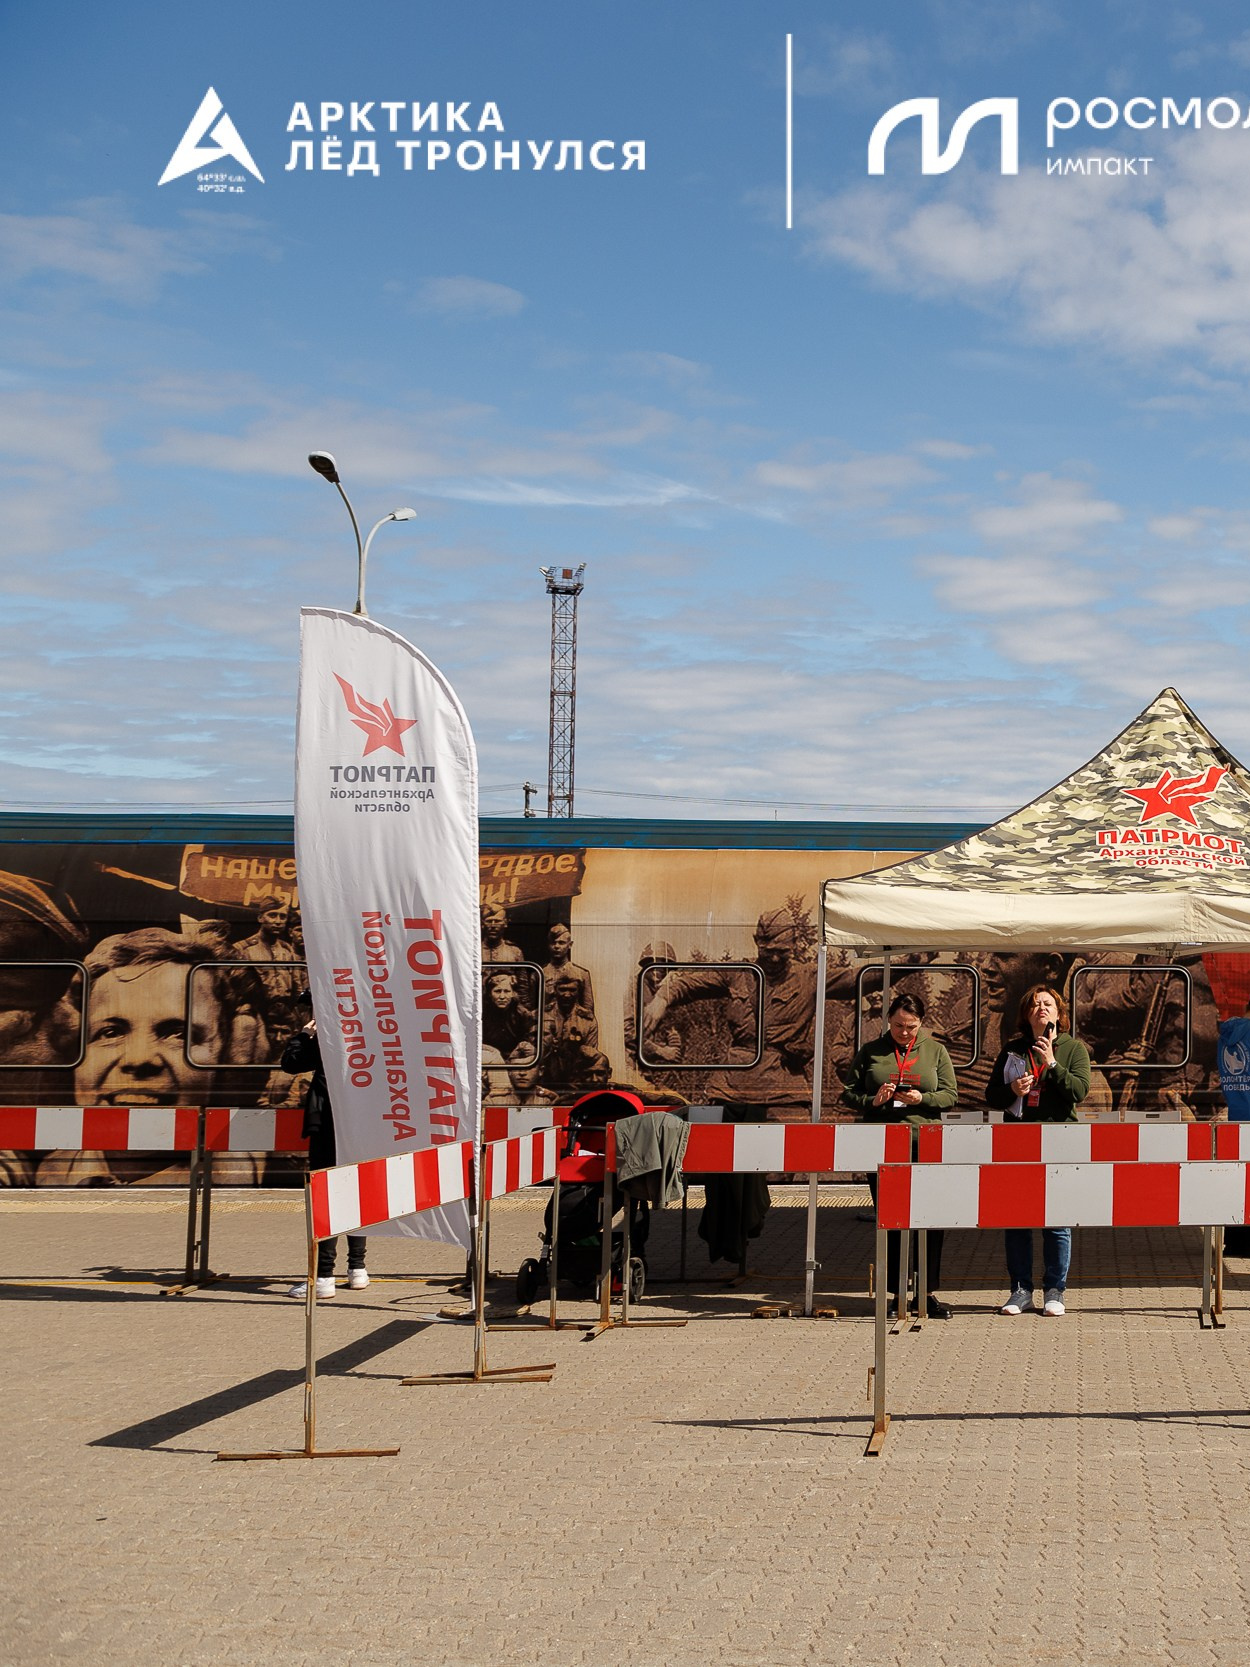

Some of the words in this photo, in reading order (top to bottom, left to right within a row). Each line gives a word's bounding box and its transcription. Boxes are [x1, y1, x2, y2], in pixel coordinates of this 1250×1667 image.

[1097, 829, 1243, 853] ПАТРИОТ
[1100, 848, 1245, 866] Архангельской
[1136, 857, 1214, 869] области
